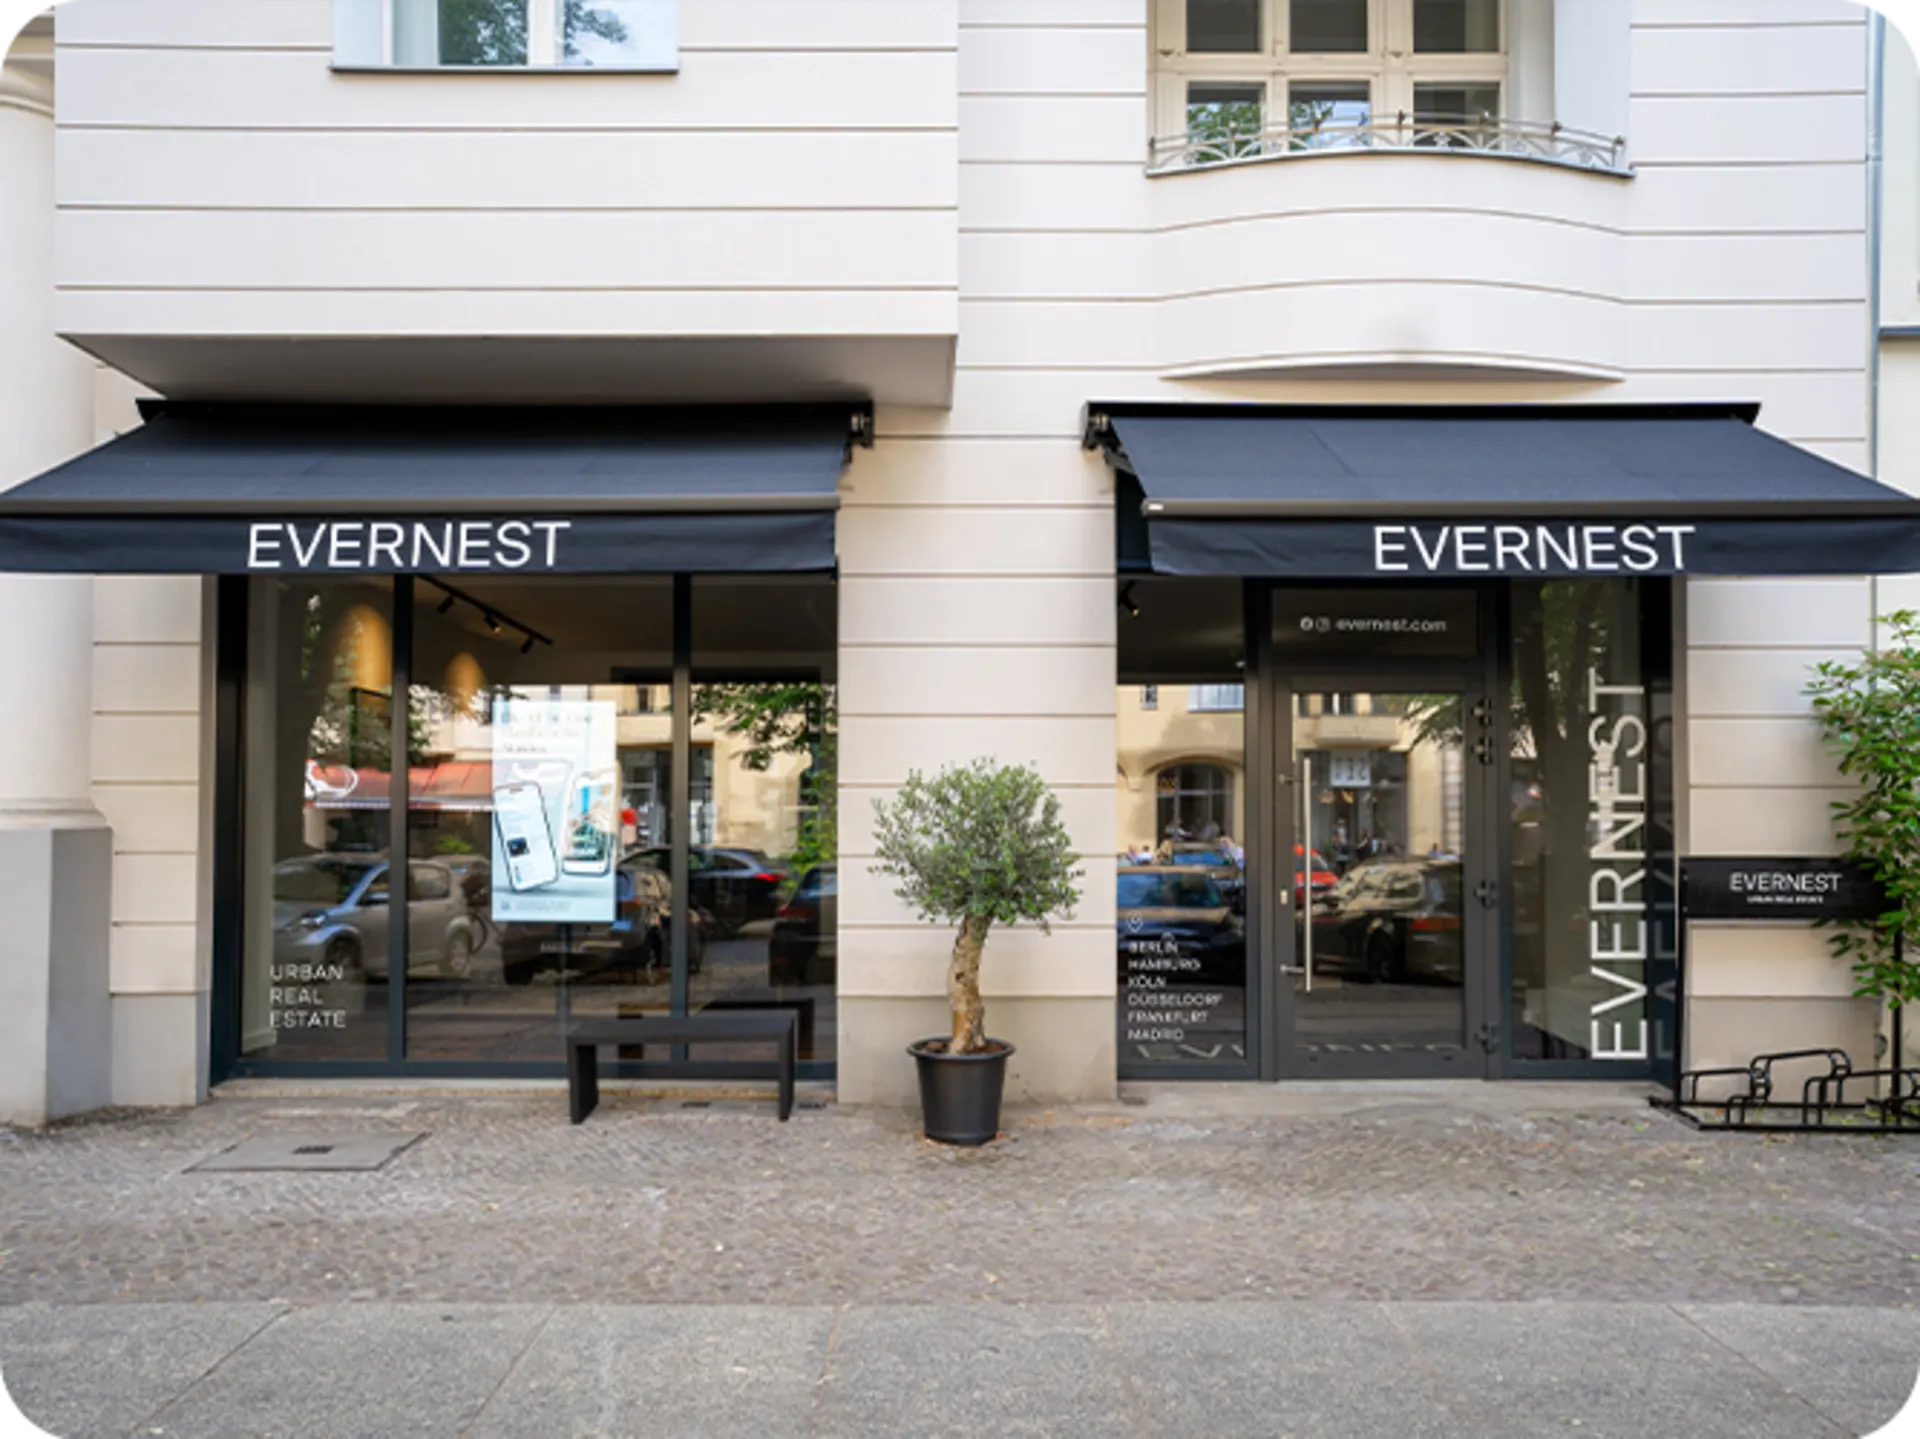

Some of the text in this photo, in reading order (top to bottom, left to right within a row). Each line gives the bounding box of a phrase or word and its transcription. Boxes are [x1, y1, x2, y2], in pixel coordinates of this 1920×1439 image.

[247, 521, 571, 568] EVERNEST
[1372, 525, 1696, 571] EVERNEST
[1335, 618, 1447, 632] evernest.com
[1588, 667, 1647, 1060] EVERNEST
[1729, 871, 1843, 892] EVERNEST
[1128, 941, 1179, 953] BERLIN
[270, 964, 344, 981] URBAN
[1128, 959, 1201, 971] HAMBURG
[270, 986, 323, 1005] REAL
[270, 1009, 346, 1029] ESTATE
[1128, 1010, 1209, 1024] FRANKFURT
[1128, 1028, 1184, 1041] MADRID
